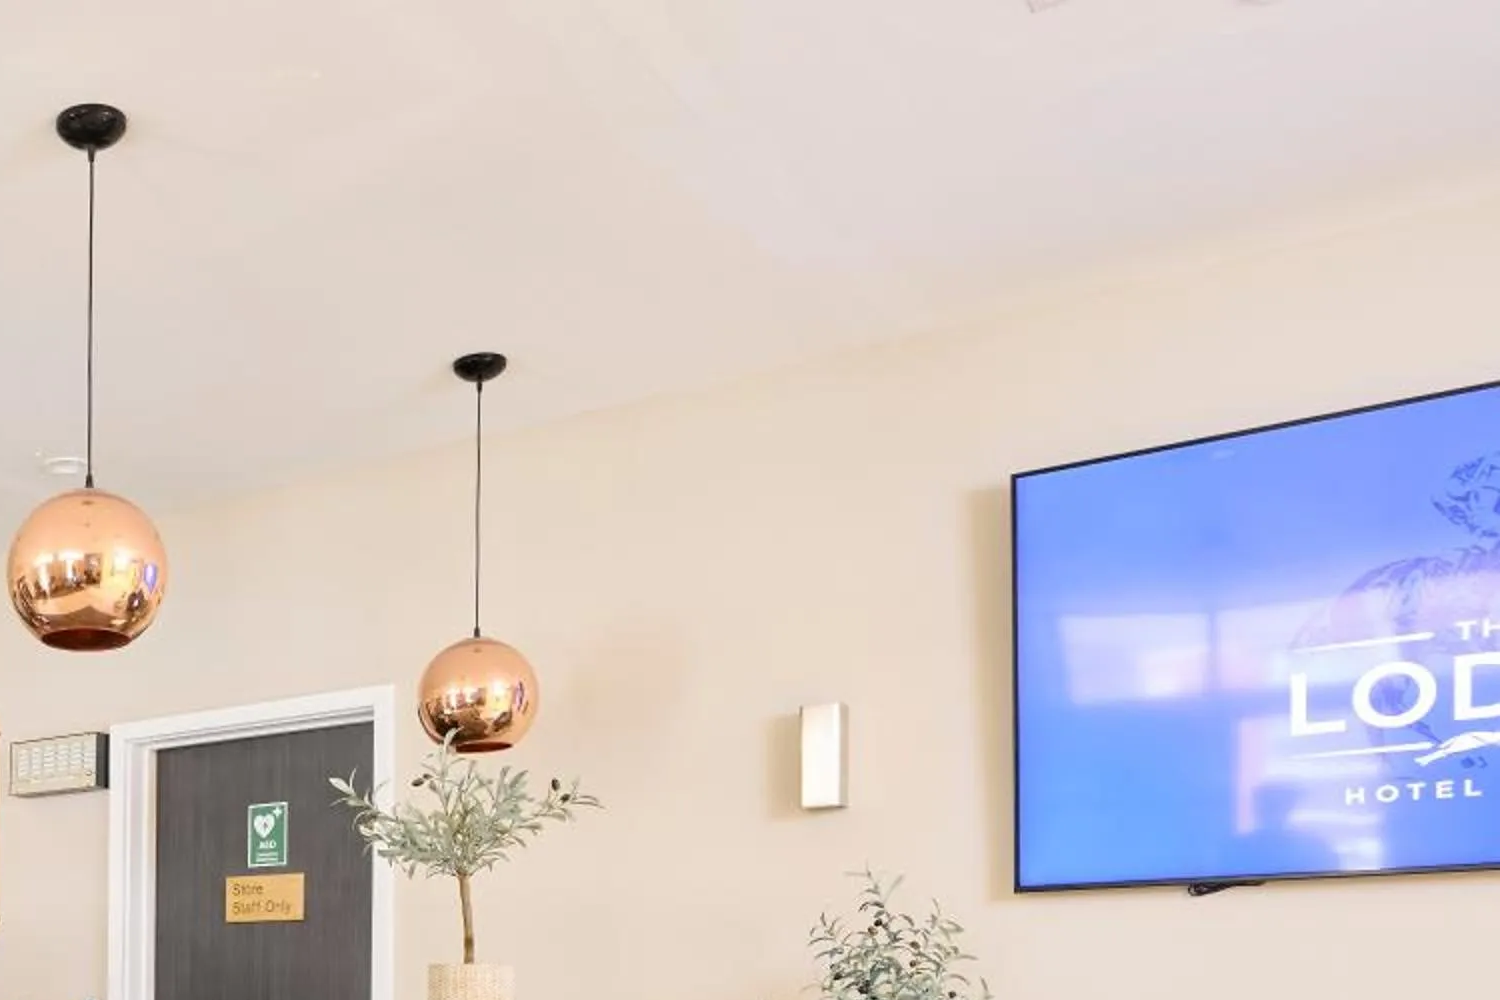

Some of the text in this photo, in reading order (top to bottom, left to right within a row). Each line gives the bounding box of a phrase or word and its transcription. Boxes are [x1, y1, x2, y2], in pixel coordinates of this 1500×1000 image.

[1345, 779, 1483, 806] HOTEL
[232, 883, 264, 897] Store
[232, 899, 292, 915] Staff Only
